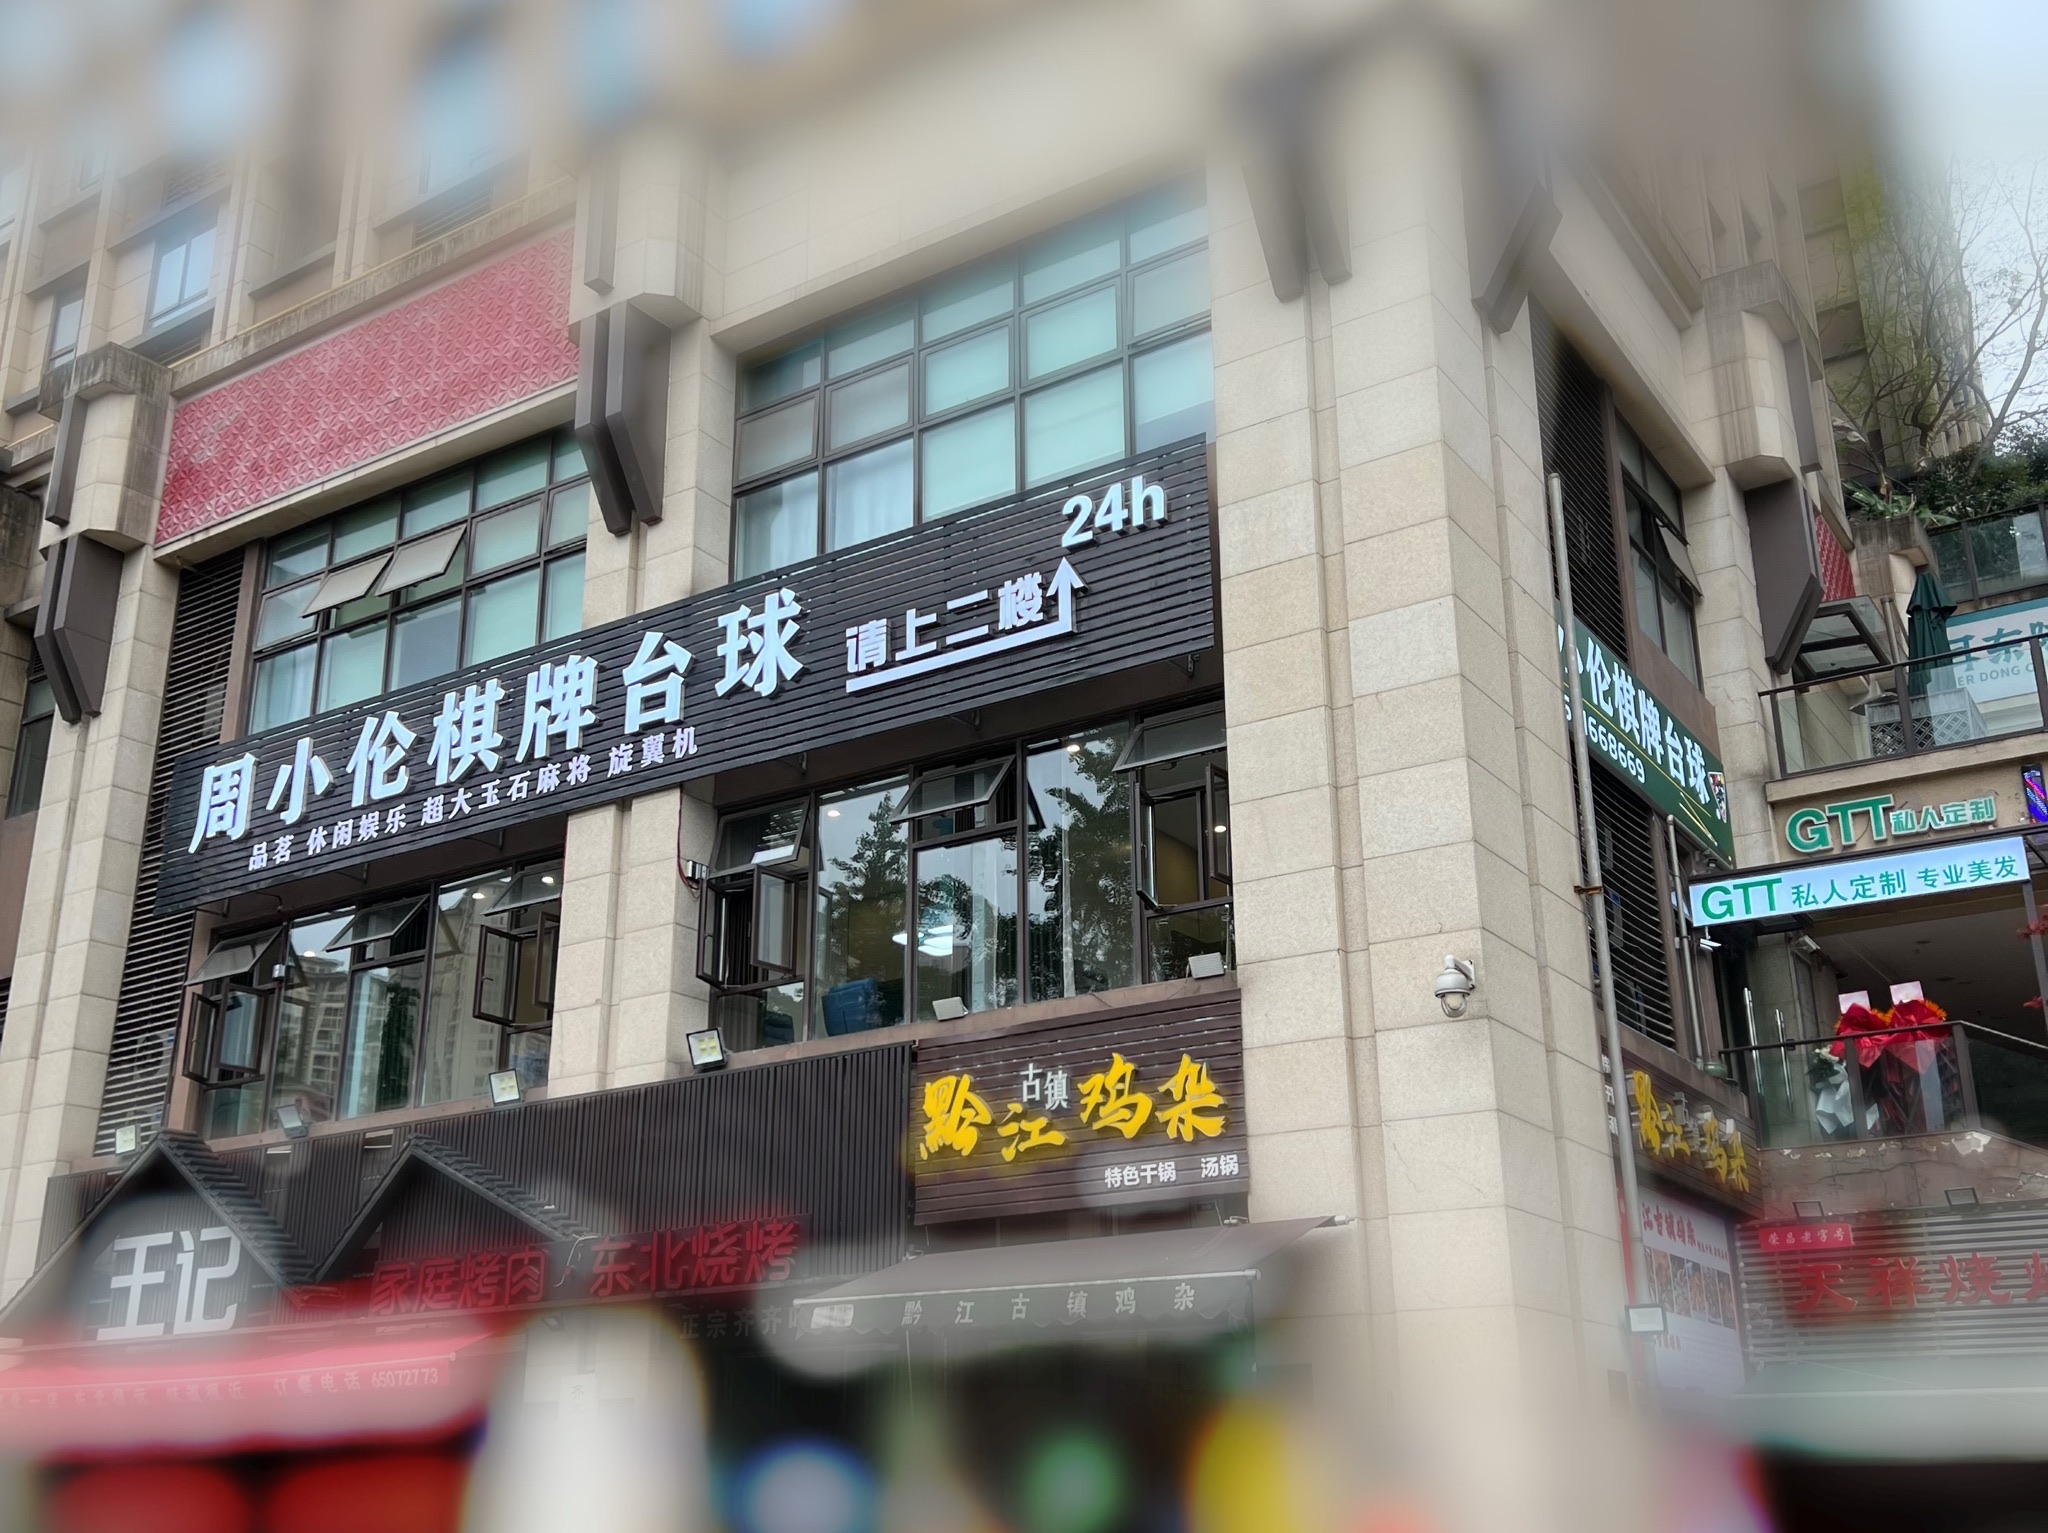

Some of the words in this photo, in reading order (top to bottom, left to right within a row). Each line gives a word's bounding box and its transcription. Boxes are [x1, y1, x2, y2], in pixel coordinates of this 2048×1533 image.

[1061, 475, 1169, 549] 24h
[846, 571, 1045, 674] 请上二楼
[1980, 665, 2021, 682] DONG
[187, 588, 804, 854] 周小伦棋牌台球
[248, 834, 294, 872] 品茗
[306, 803, 407, 856] 休闲娱乐
[420, 754, 593, 826] 超大玉石麻将
[607, 726, 698, 778] 旋翼机
[1785, 794, 1896, 853] GTT
[1889, 795, 1998, 836] 私人定制
[1700, 878, 1783, 921] GTT
[1791, 868, 1907, 908] 私人定制
[1916, 854, 2020, 890] 专业美发
[1019, 1063, 1071, 1111] 古镇
[1103, 1160, 1177, 1189] 特色干锅
[1199, 1153, 1240, 1178] 汤锅
[97, 1225, 242, 1342] 王记
[372, 1246, 549, 1318] 家庭烤肉
[590, 1216, 799, 1297] 东北烧烤
[370, 1367, 439, 1389] 65072773
